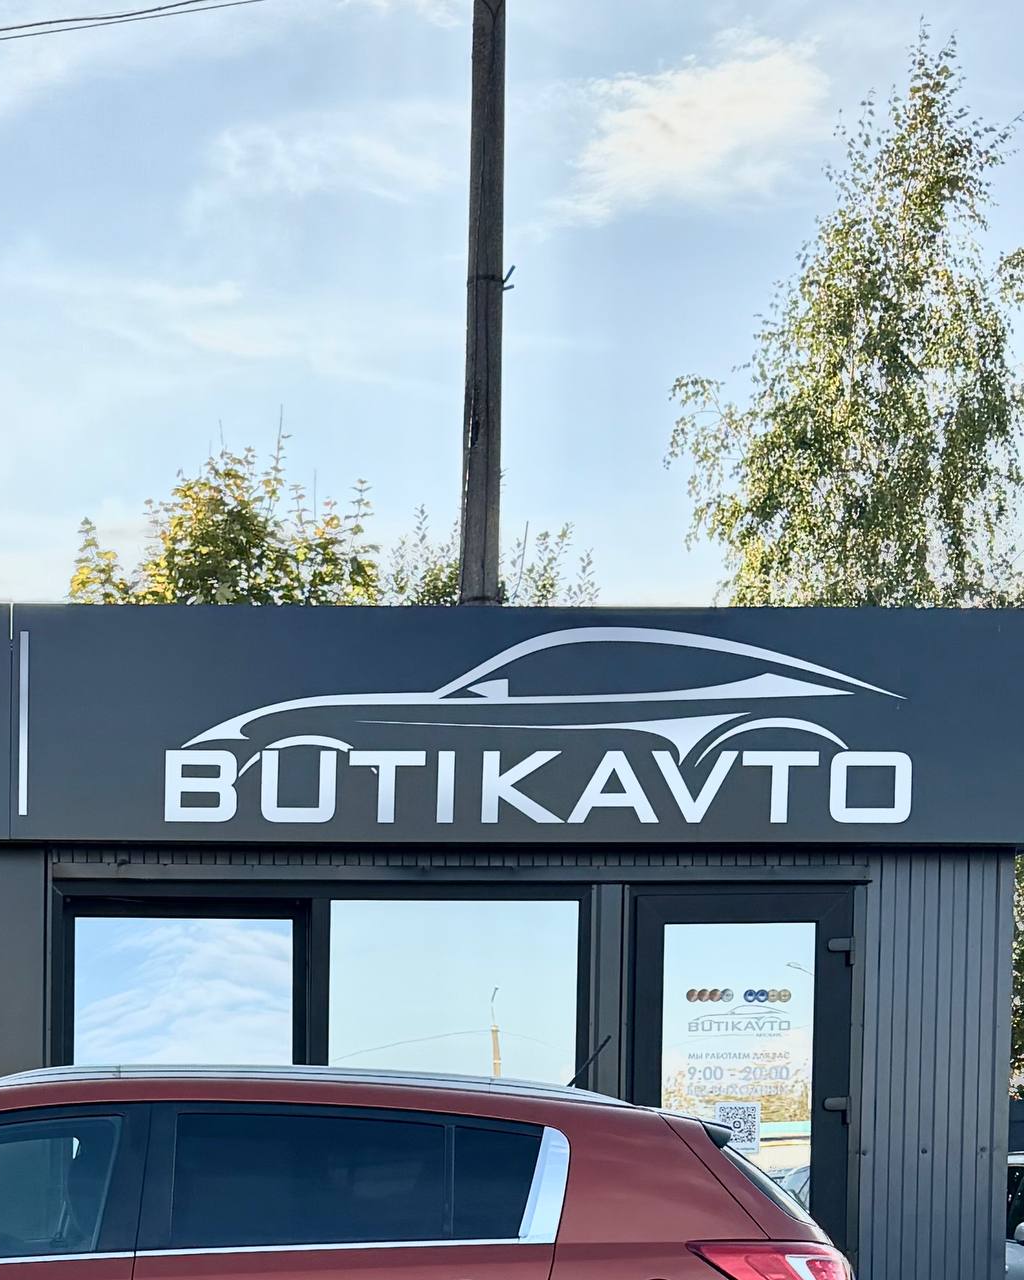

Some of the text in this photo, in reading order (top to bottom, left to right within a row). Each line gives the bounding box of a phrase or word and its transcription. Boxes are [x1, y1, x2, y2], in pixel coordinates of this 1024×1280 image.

[164, 748, 913, 824] BUTIKAVTO
[688, 1020, 791, 1032] BUTIKAVTO
[687, 1066, 723, 1081] 9:00
